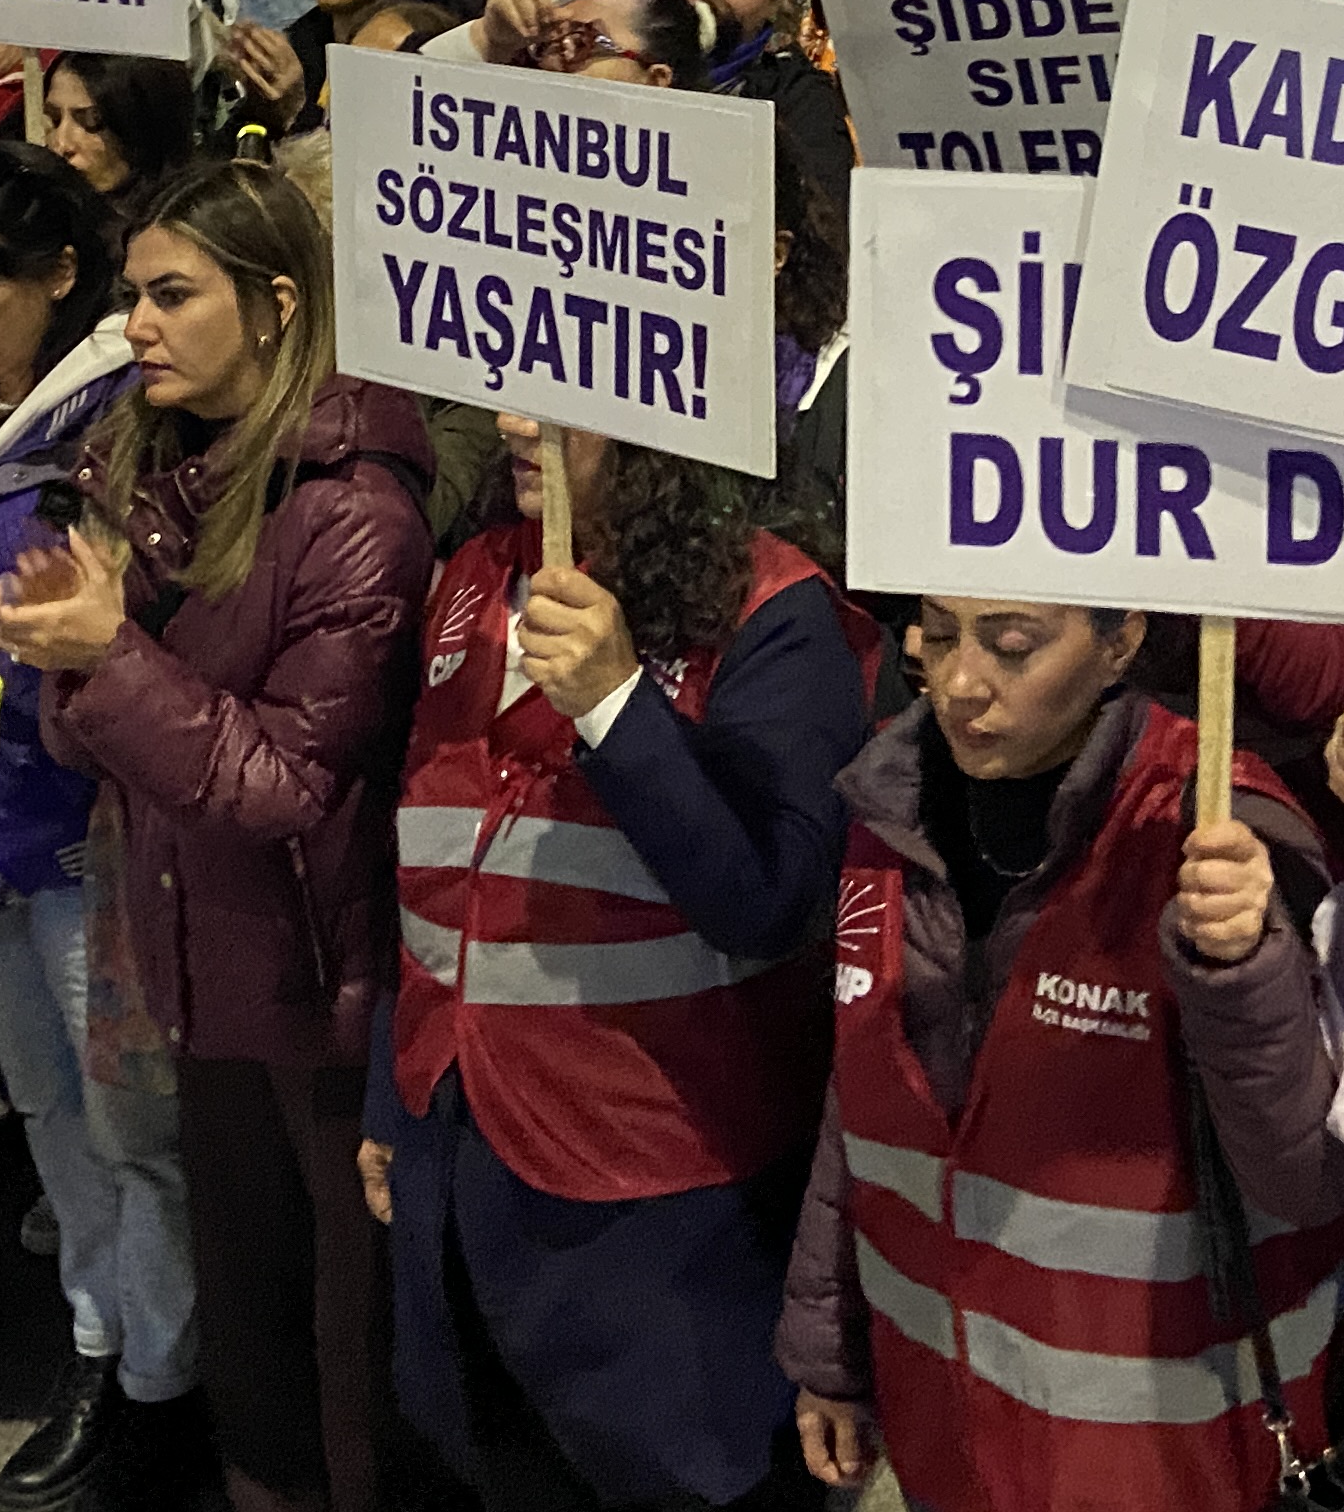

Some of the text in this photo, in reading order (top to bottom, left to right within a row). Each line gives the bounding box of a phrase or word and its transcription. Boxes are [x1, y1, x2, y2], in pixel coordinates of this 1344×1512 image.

[412, 75, 687, 196] İSTANBUL
[967, 51, 1119, 107] SIFI
[376, 163, 727, 297] SÖZLEŞMESİ
[383, 253, 708, 420] YAŞATIR!
[949, 432, 1216, 561] DUR
[835, 963, 873, 1005] HP
[1034, 972, 1151, 1018] KONAK
